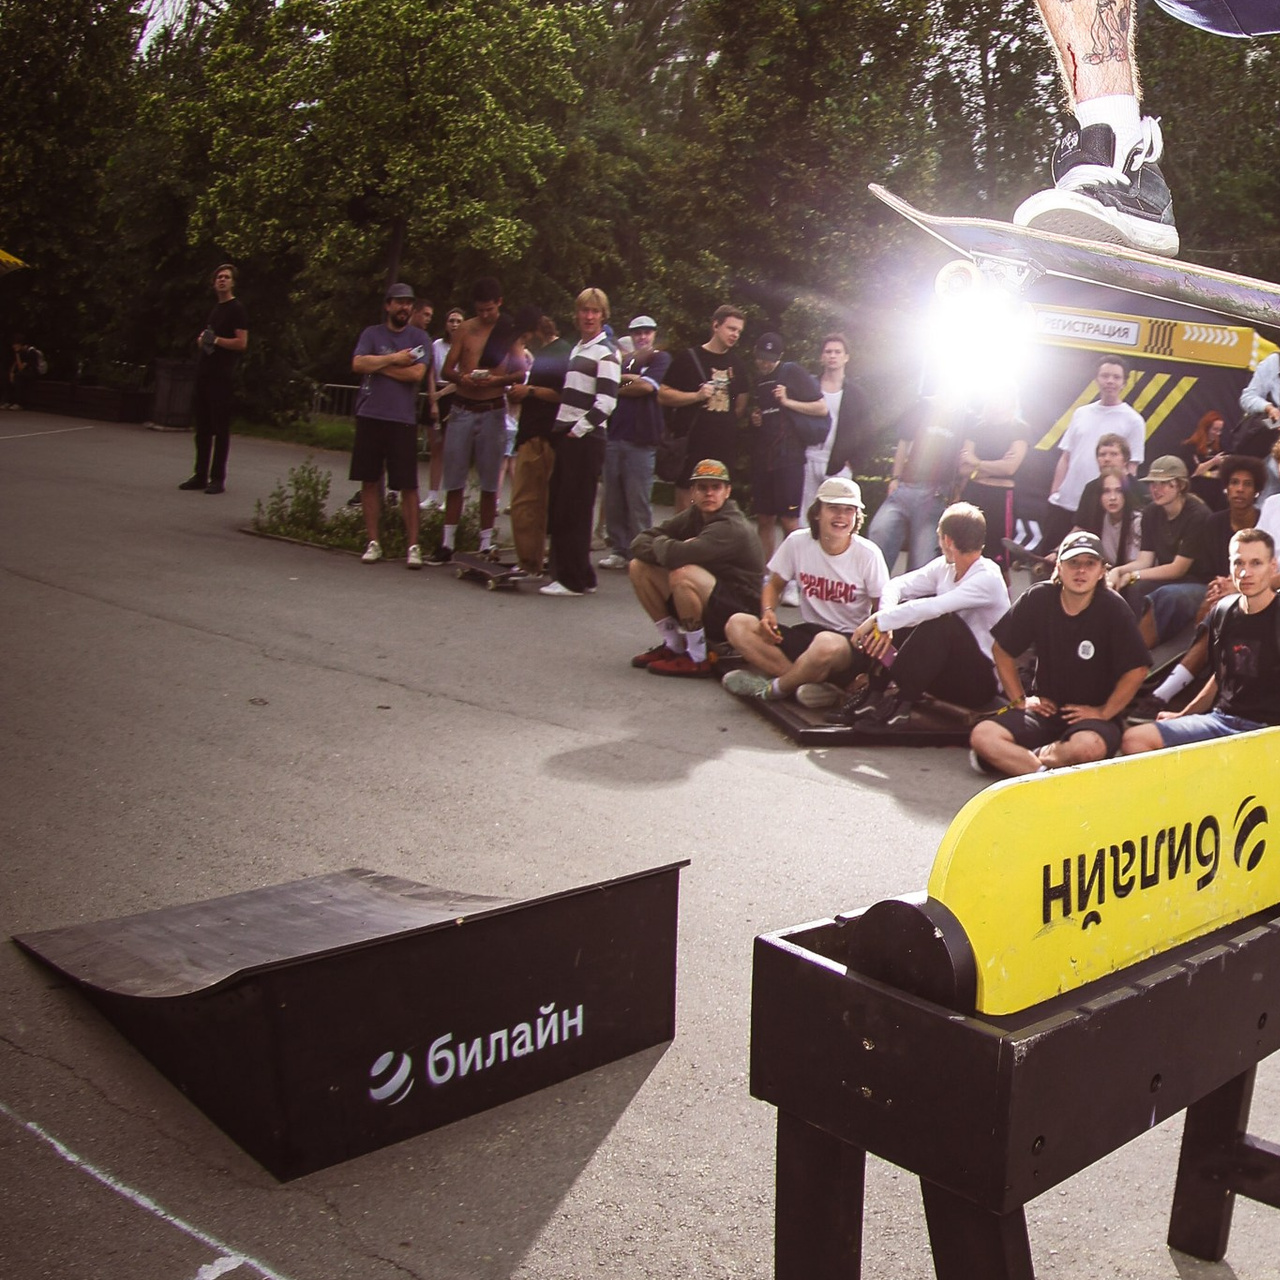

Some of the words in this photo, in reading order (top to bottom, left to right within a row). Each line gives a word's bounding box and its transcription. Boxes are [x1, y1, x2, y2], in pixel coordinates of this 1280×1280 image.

[1045, 317, 1131, 339] РЕГИСТРАЦИЯ
[1042, 814, 1221, 930] билайн
[427, 1002, 583, 1085] билайн
